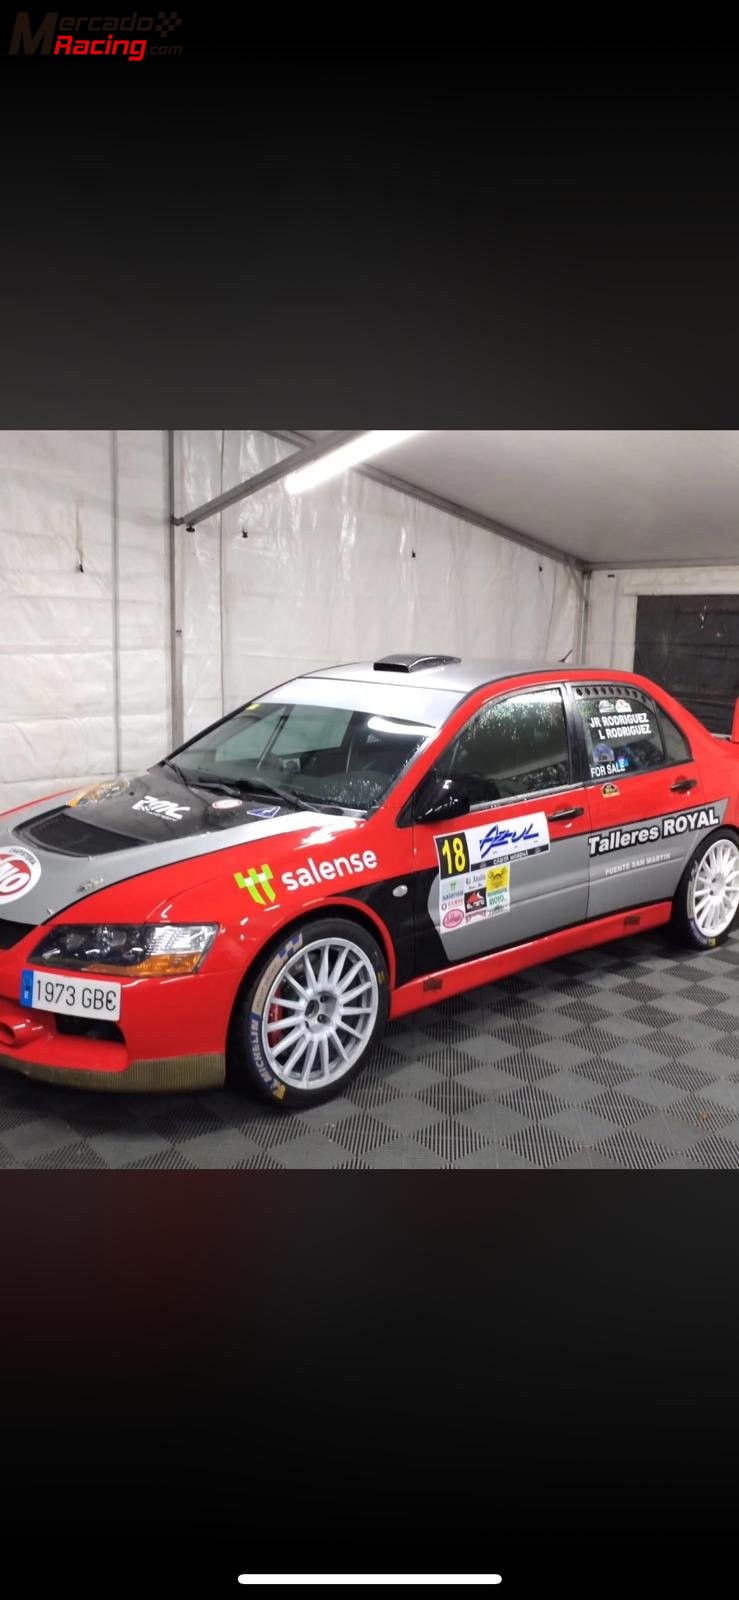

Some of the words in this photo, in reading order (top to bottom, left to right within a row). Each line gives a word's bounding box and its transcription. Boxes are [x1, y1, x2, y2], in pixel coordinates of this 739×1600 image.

[590, 717, 601, 728] JR
[602, 713, 649, 726] RODRIGUEZ
[598, 729, 605, 739] L
[606, 724, 651, 738] RODRIGUEZ
[590, 766, 606, 778] FOR
[607, 762, 626, 774] SALE
[588, 826, 660, 855] Talleres
[663, 808, 719, 837] ROYAL
[281, 850, 378, 891] salense
[442, 837, 466, 875] 18
[631, 858, 645, 868] SAN
[37, 980, 76, 1007] 1973
[81, 987, 117, 1012] GBE
[251, 1019, 273, 1083] MICHELIN
